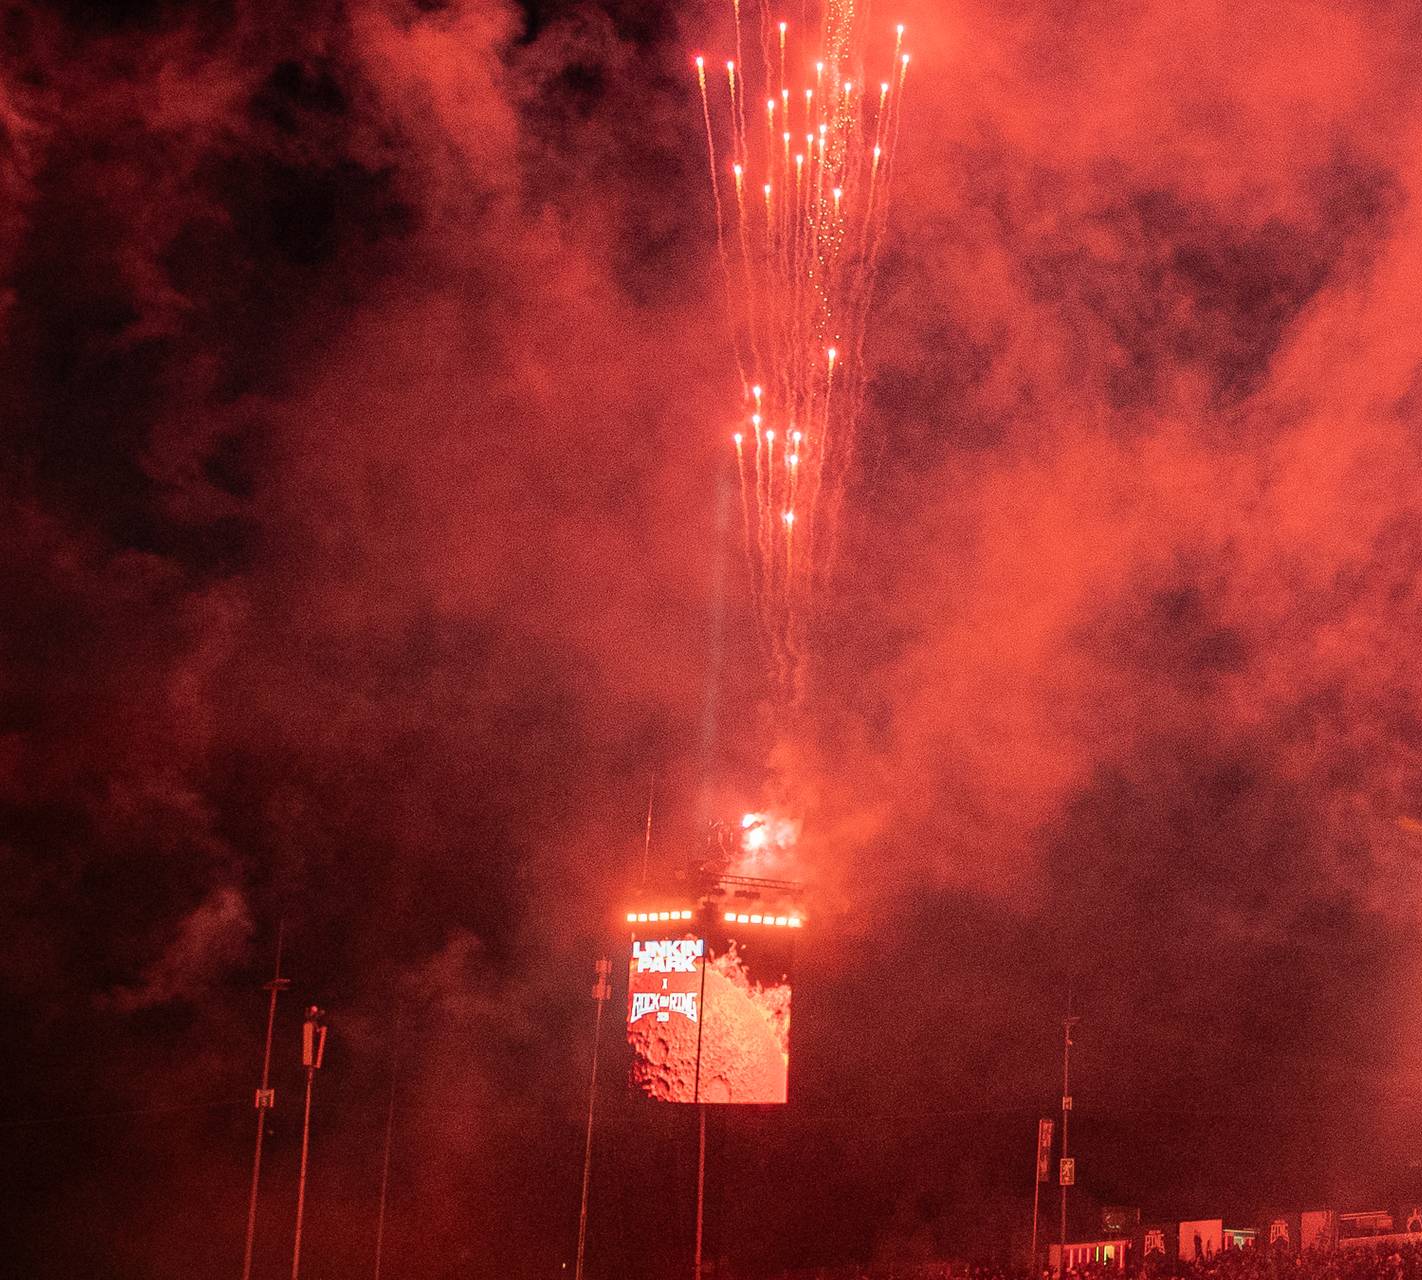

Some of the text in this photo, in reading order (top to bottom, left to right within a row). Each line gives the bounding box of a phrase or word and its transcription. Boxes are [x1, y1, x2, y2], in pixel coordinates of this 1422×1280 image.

[633, 940, 703, 958] LINKIN
[638, 954, 697, 973] PARK
[630, 993, 660, 1024] ROCK
[669, 992, 698, 1022] RING
